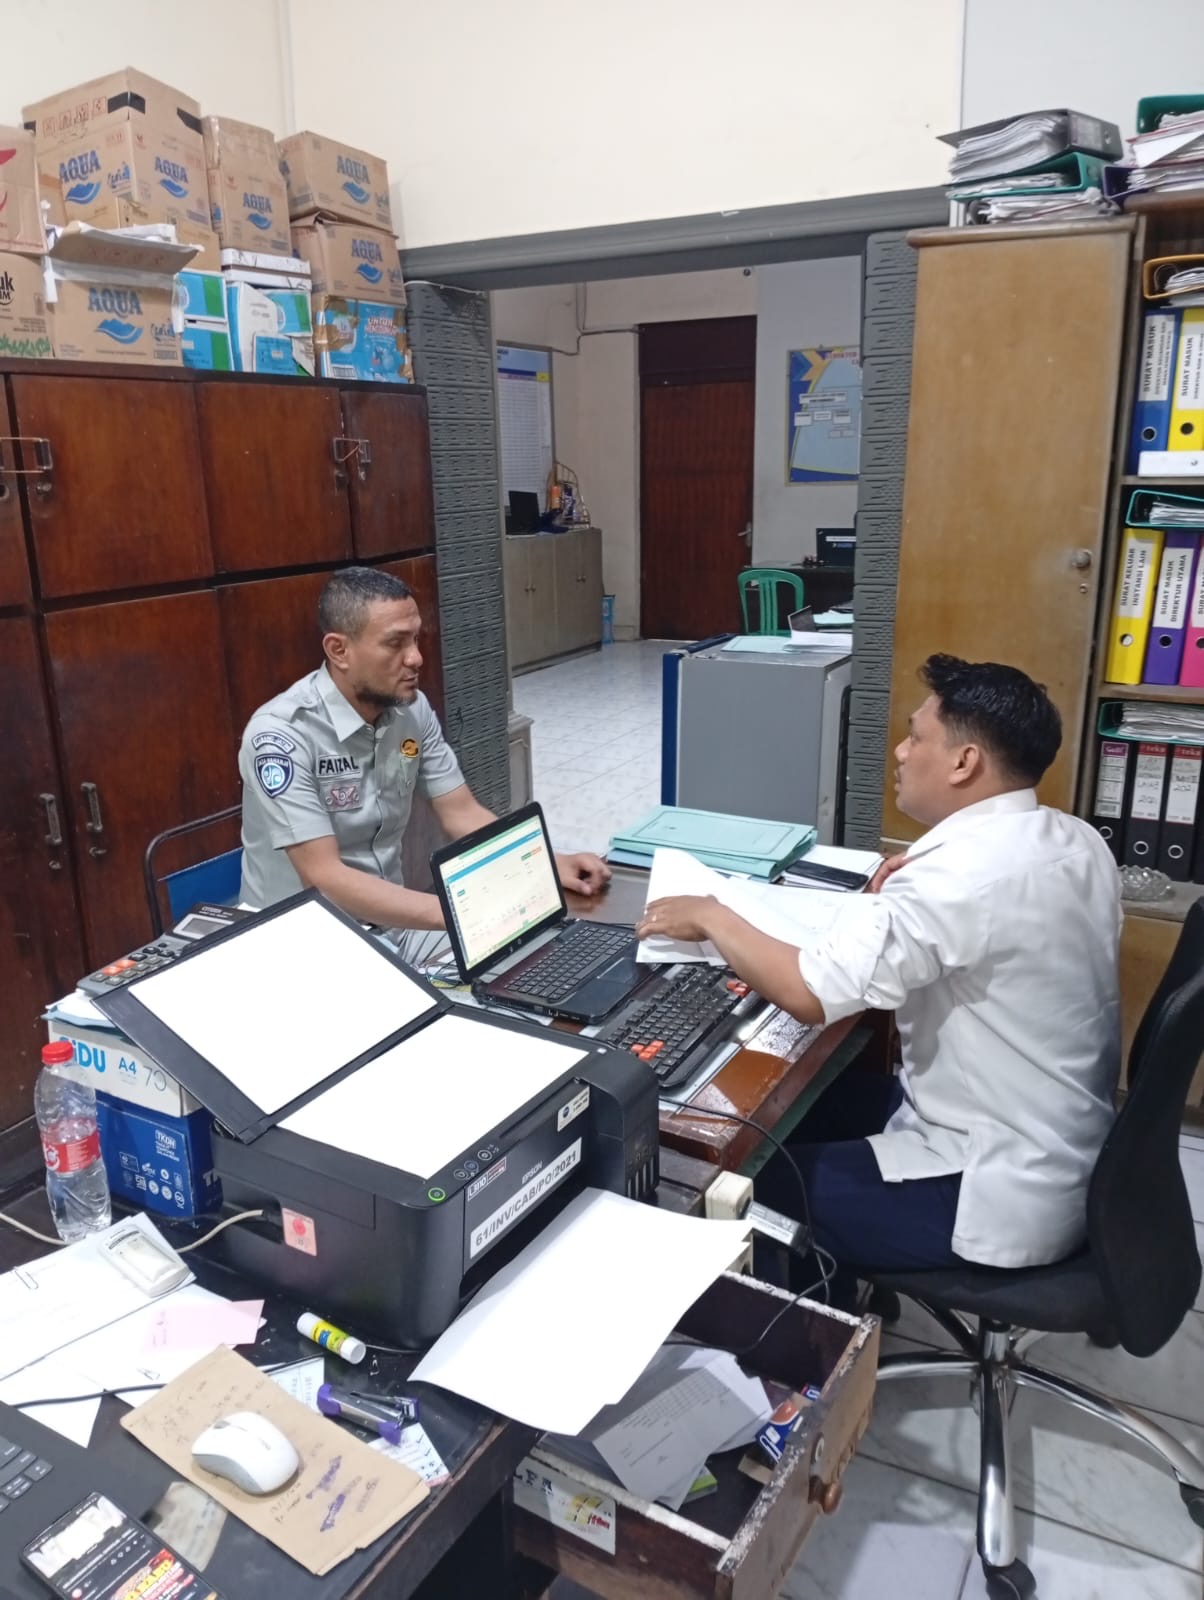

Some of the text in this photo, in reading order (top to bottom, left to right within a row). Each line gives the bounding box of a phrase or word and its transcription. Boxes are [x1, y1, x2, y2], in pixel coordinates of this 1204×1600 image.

[59, 150, 101, 183] AQUA
[154, 156, 189, 183] AQUA
[337, 155, 371, 184] AQUA
[243, 192, 272, 213] AQUA
[351, 238, 384, 263] AQUA
[88, 287, 143, 318] AQUA
[1142, 325, 1156, 393] SURAT MASUK
[1181, 336, 1193, 396] SURAT MASUK
[1120, 548, 1135, 606] SURAT KELUAR
[1132, 550, 1147, 606] INSTANSI LAIN
[1160, 560, 1174, 615] SURAT MASUK
[1170, 554, 1187, 622] DIREKTUR UTAMA
[318, 756, 359, 775] FAIZAL
[60, 1036, 106, 1073] iDU
[119, 1057, 137, 1075] A4
[522, 1161, 543, 1185] EPSON
[476, 1150, 576, 1246] 61/INV/CAB/PO/2021
